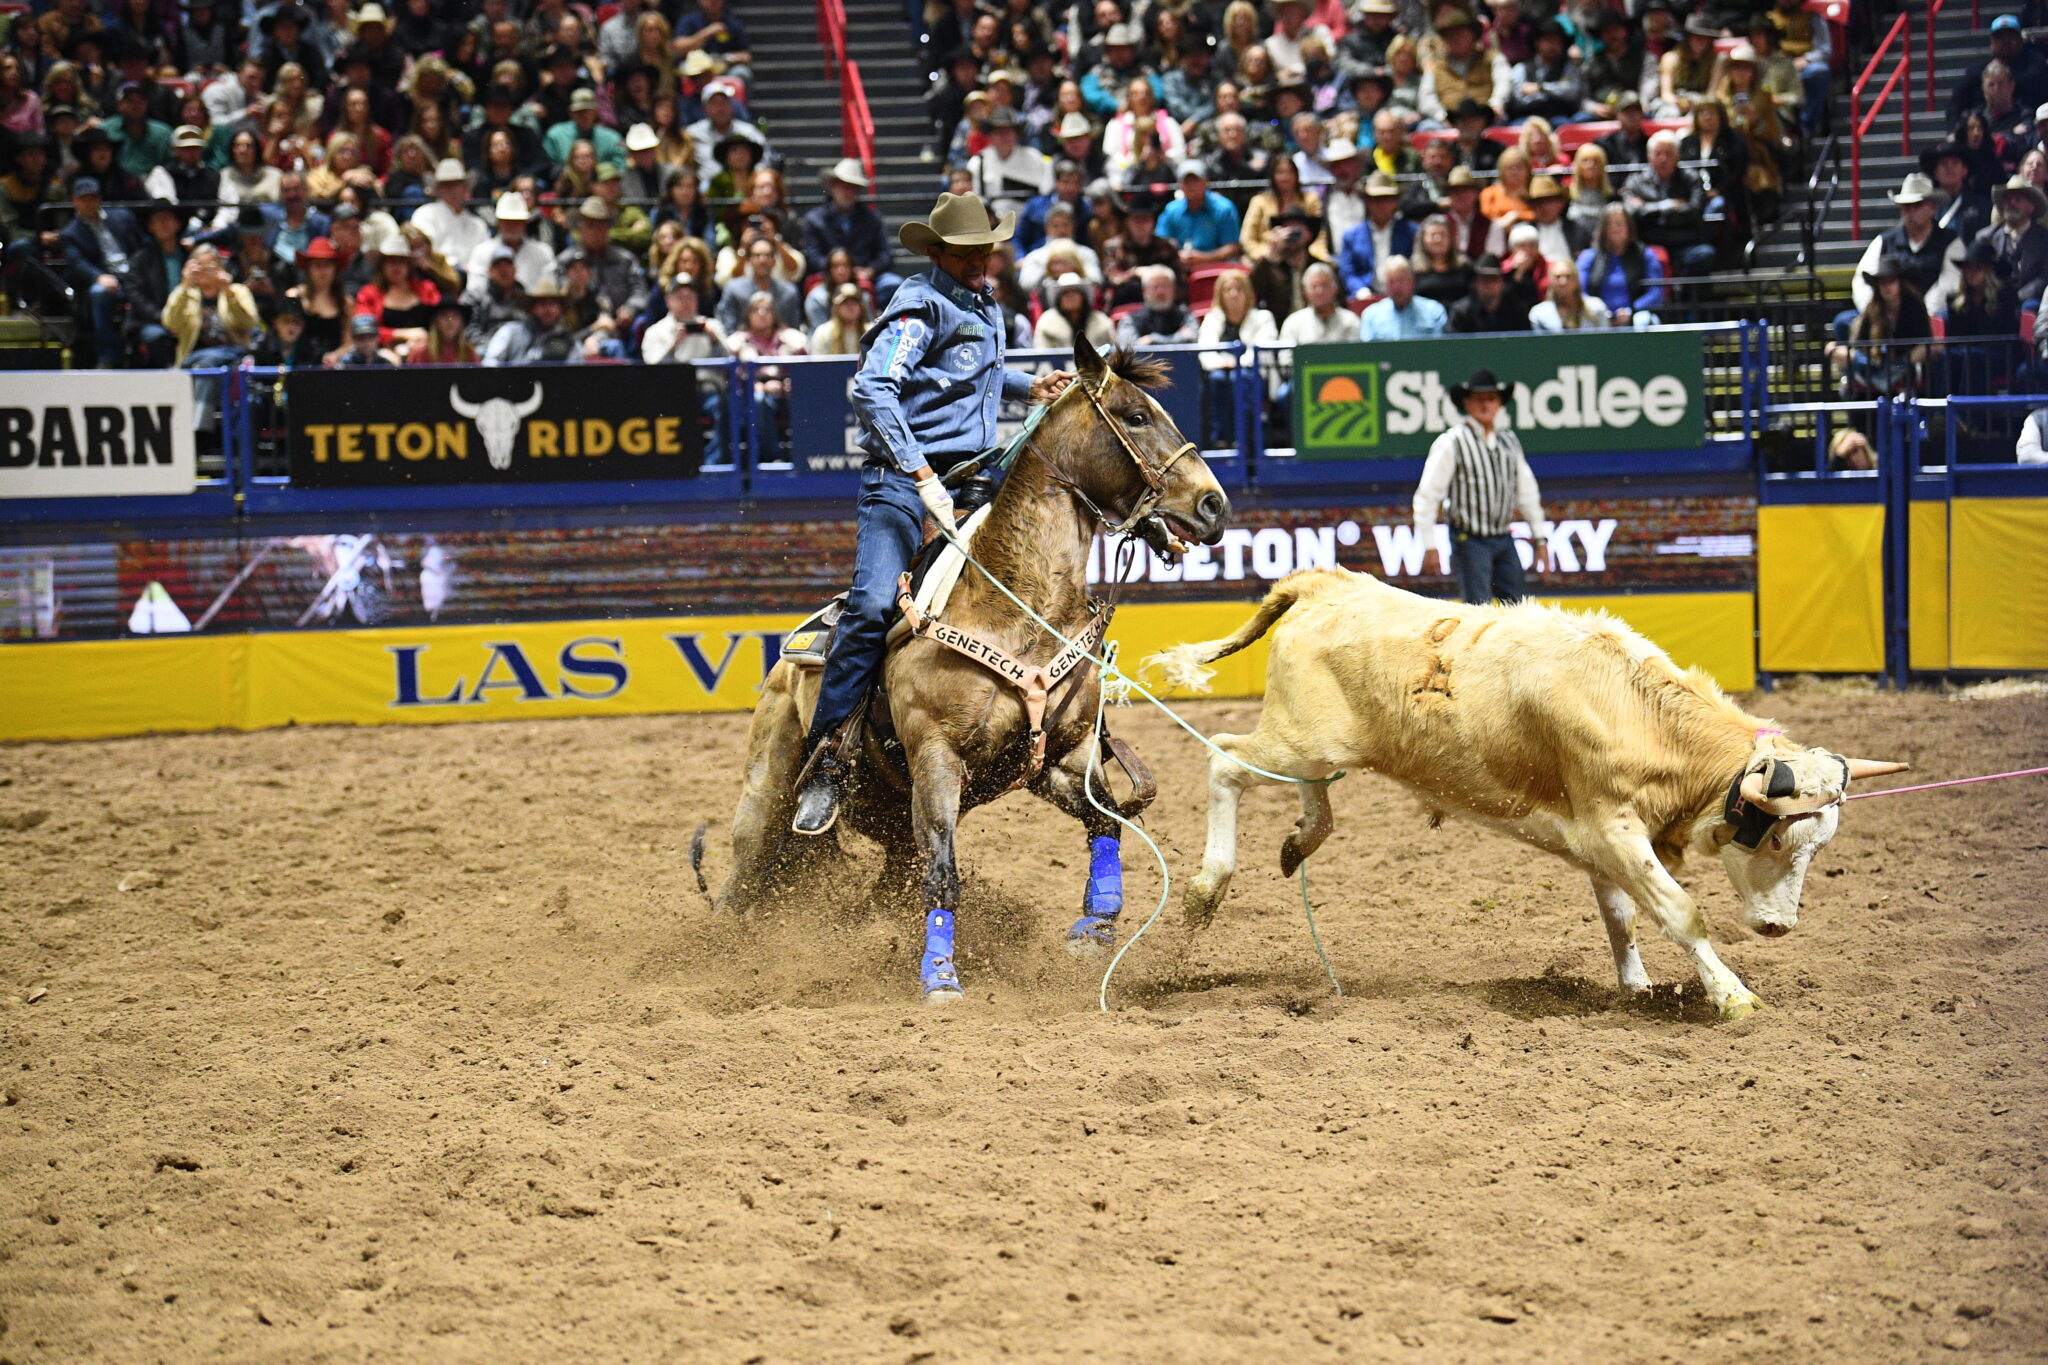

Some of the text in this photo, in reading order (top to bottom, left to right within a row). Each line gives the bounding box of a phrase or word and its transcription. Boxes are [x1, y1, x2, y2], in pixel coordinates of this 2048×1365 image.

[0, 405, 175, 467] BARN
[304, 416, 683, 462] TETON RIDGE
[1371, 518, 1617, 577] WSKY
[386, 635, 630, 707] LAS
[935, 627, 1025, 680] GENETECH
